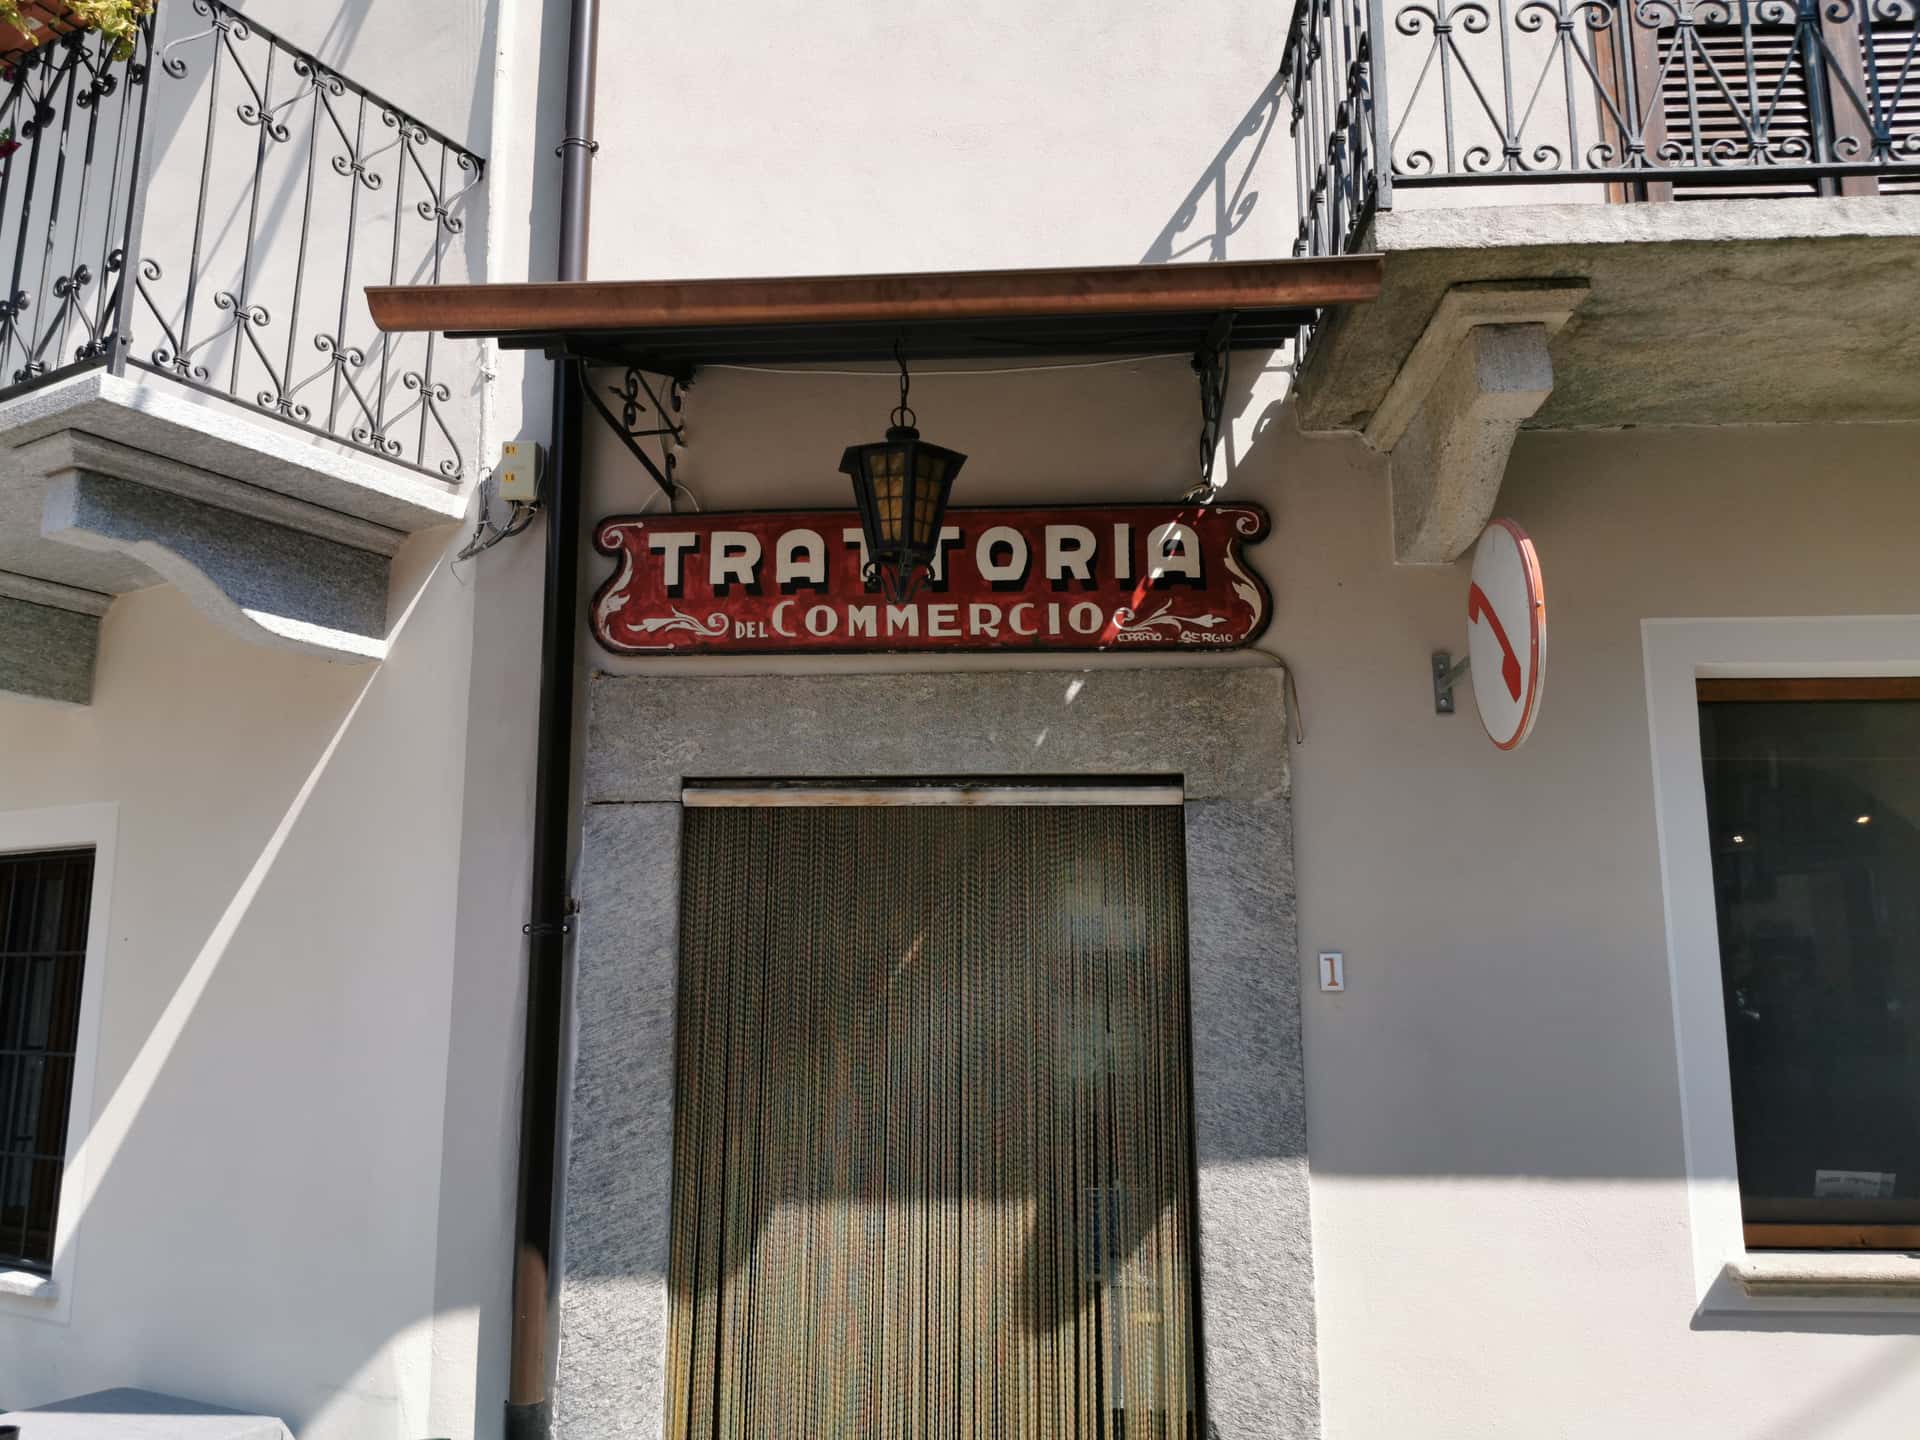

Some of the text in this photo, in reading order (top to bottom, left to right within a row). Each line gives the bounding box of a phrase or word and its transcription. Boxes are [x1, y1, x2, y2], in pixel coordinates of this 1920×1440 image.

[735, 600, 1104, 639] DEL COMMERCIO
[1179, 630, 1233, 643] SERGIO
[1323, 957, 1339, 987] 1
